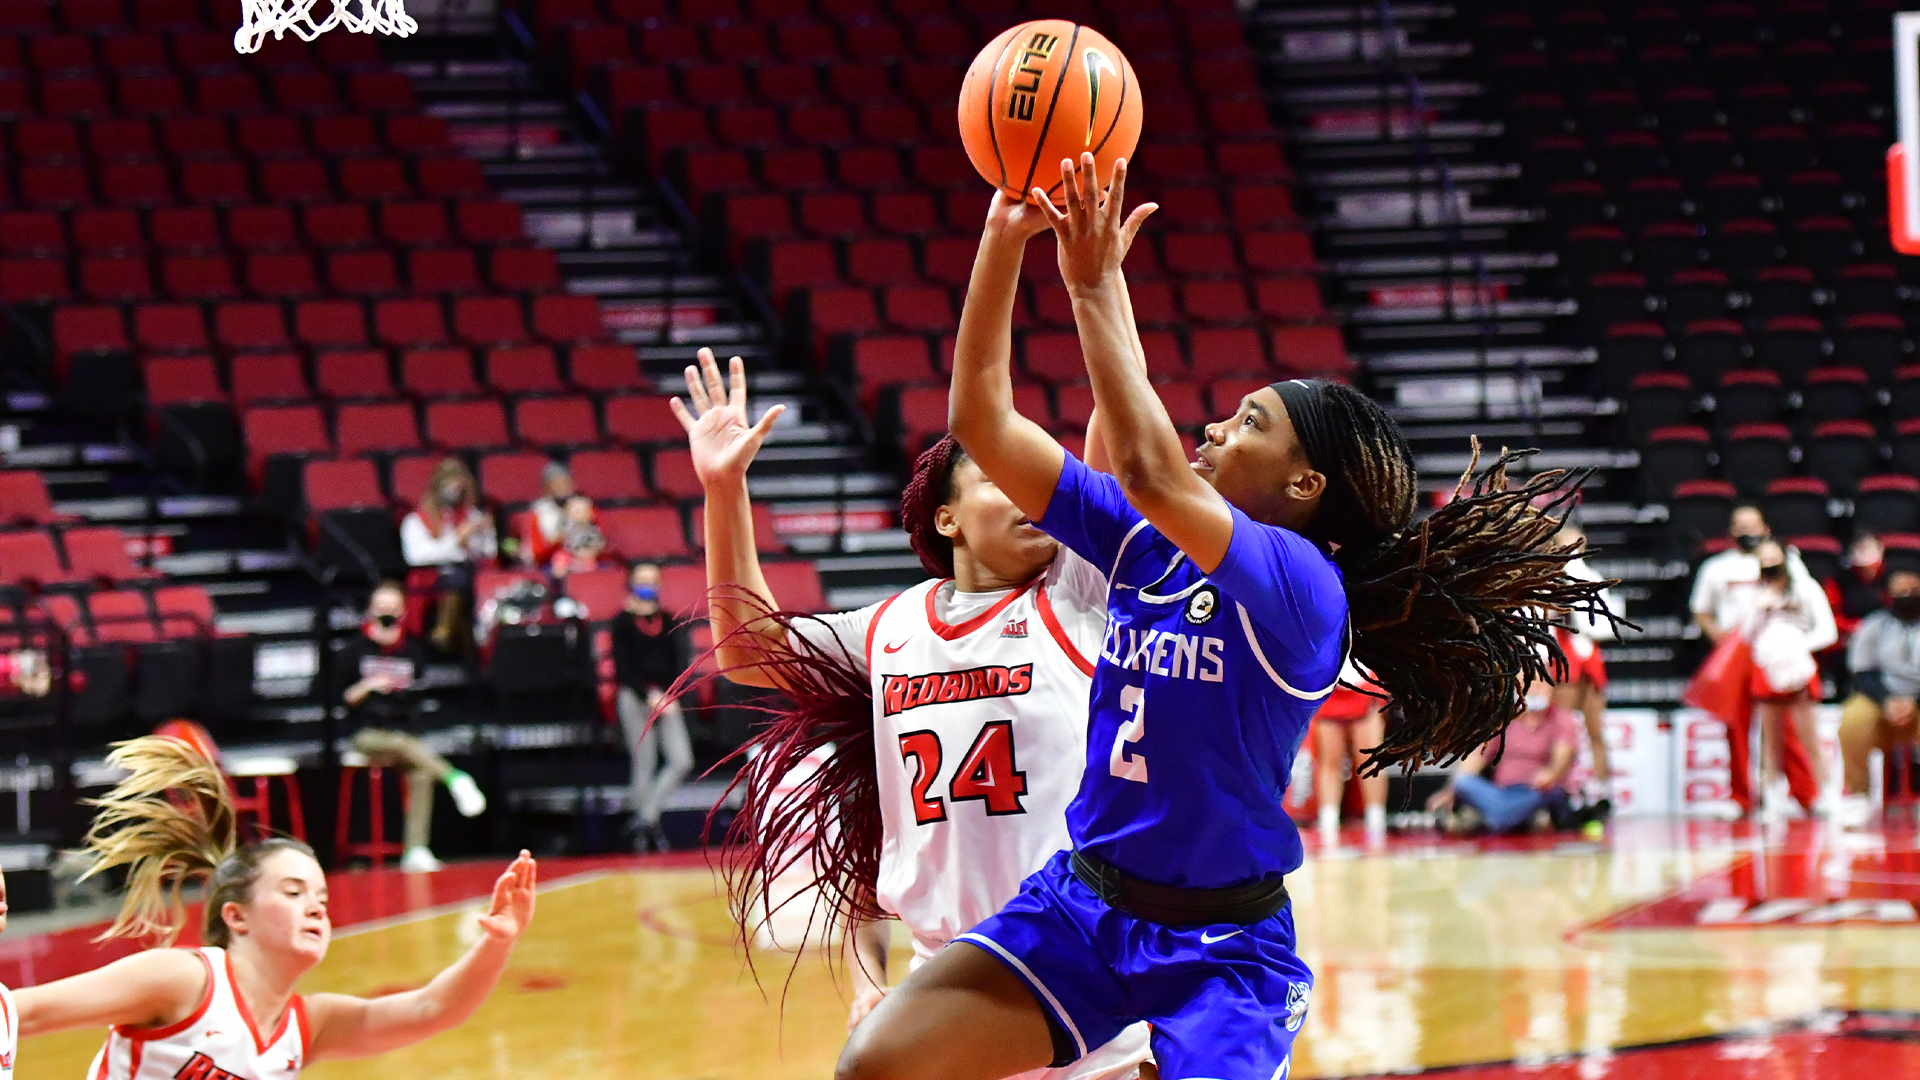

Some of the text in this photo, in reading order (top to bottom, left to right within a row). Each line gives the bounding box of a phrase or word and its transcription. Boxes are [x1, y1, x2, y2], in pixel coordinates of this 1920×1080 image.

[1008, 32, 1060, 122] ELITE
[881, 662, 1034, 717] REDBIRDS
[1110, 684, 1148, 783] 2
[898, 719, 1029, 826] 24
